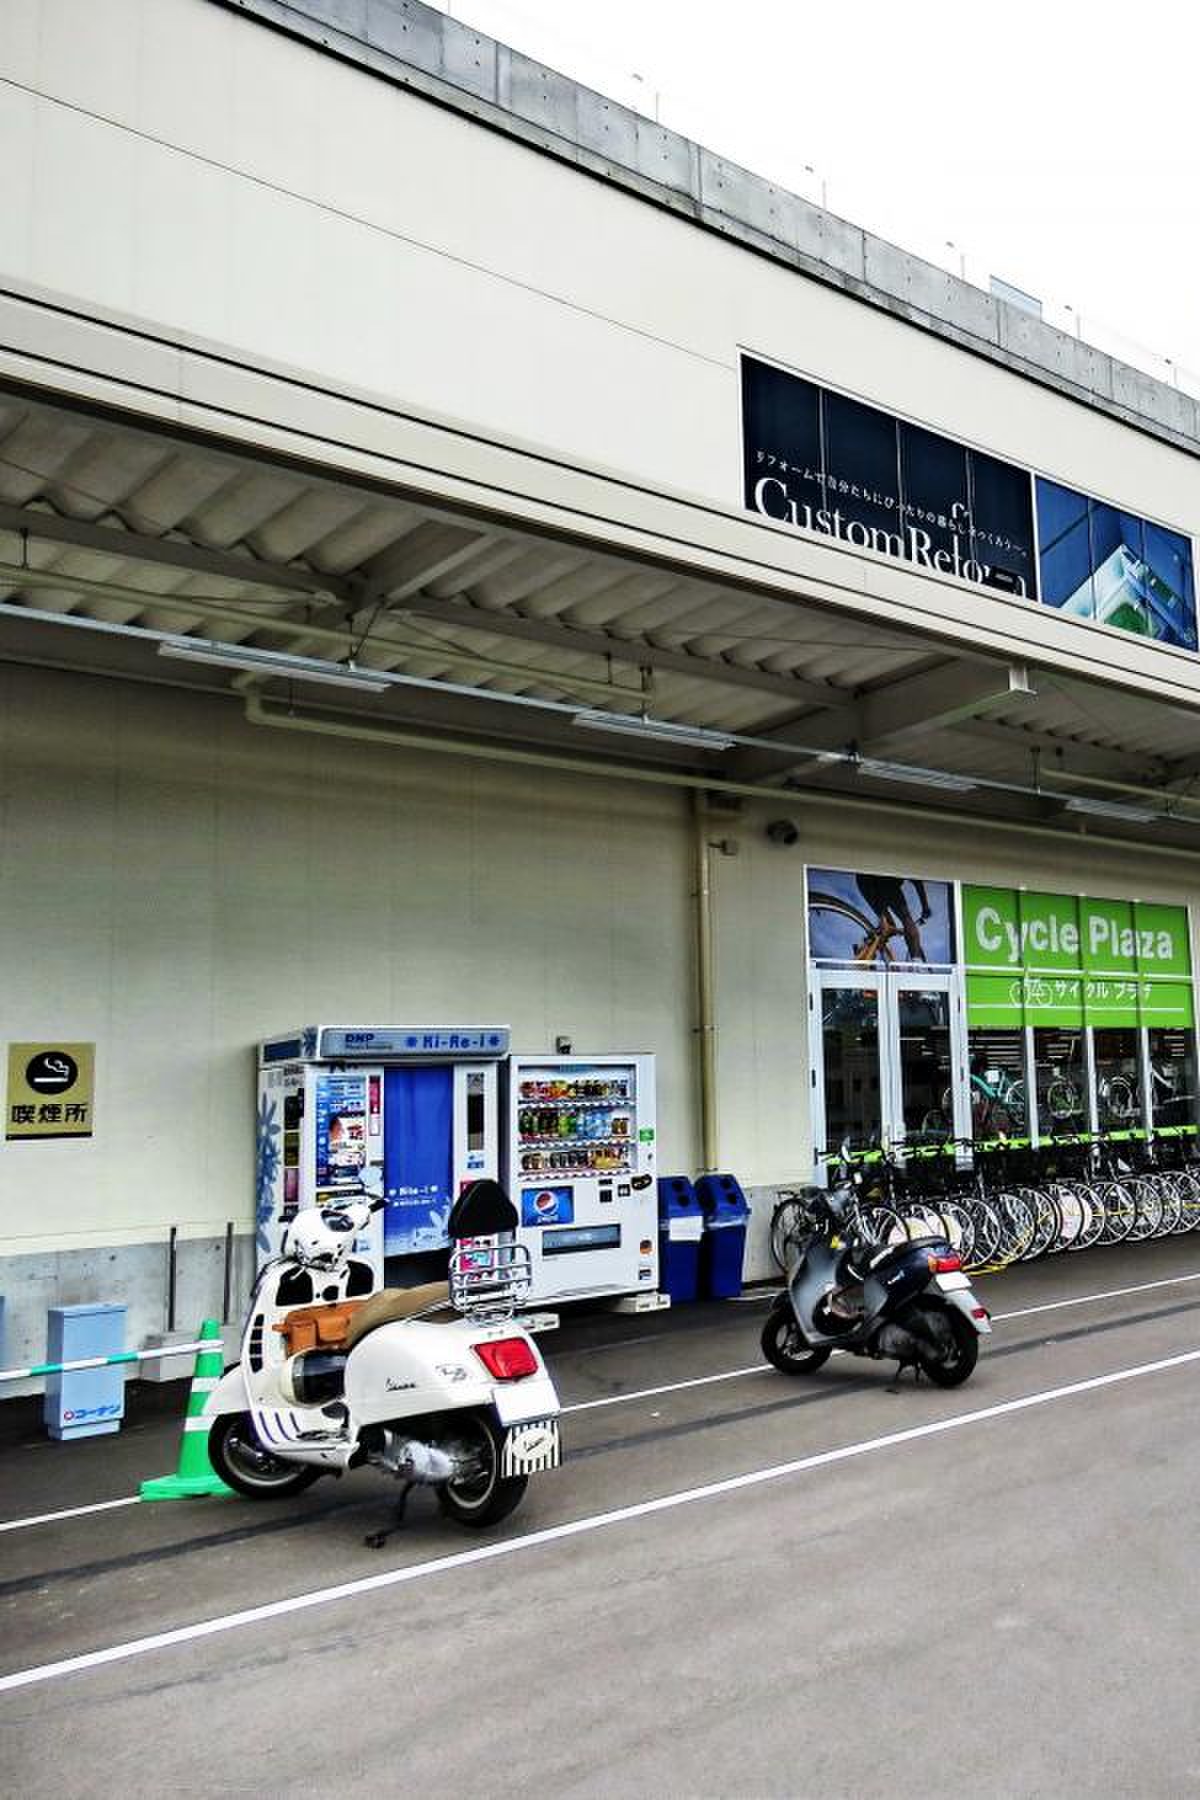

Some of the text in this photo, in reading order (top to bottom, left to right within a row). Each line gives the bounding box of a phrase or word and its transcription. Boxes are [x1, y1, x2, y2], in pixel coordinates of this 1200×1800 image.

[975, 906, 1174, 962] Cycle Plaza
[345, 1033, 375, 1042] DNP
[11, 1102, 88, 1125] 喫煙所
[75, 1405, 121, 1419] コーナン
